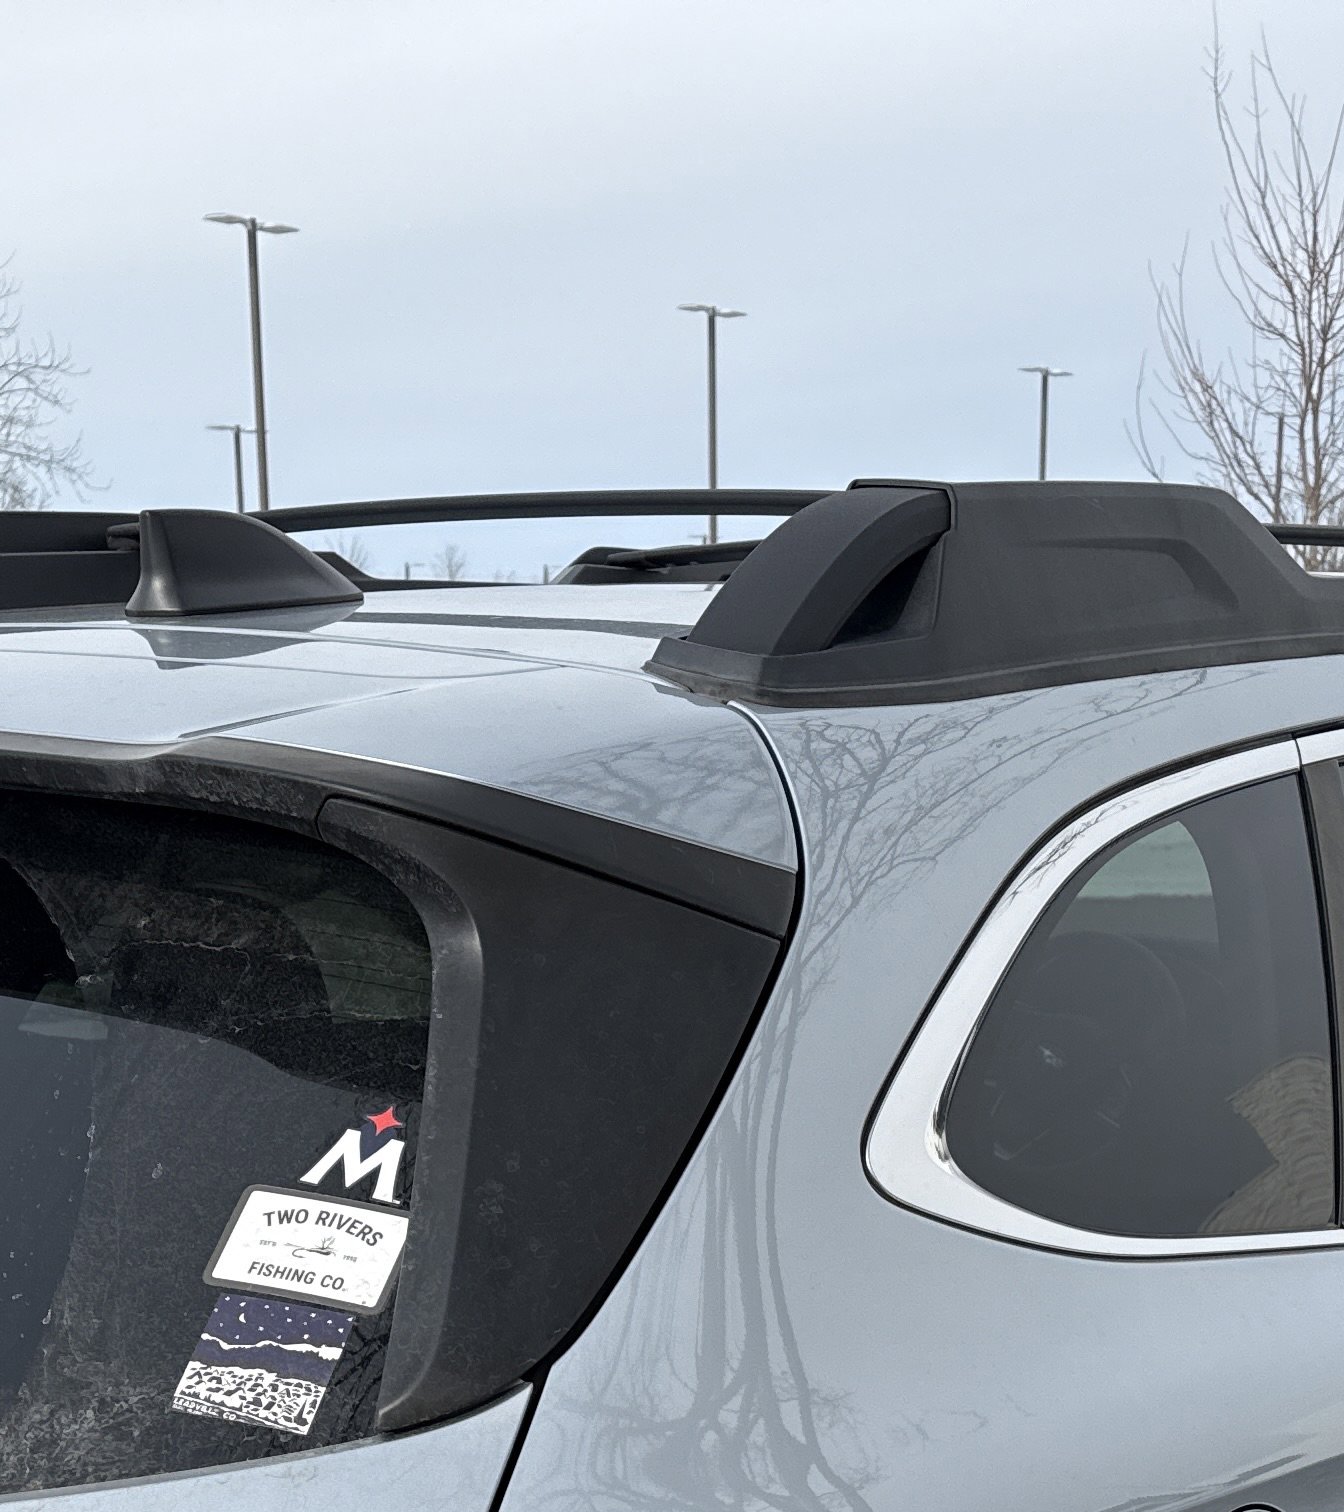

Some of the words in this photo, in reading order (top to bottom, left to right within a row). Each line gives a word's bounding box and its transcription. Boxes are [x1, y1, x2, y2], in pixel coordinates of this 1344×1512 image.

[262, 1208, 309, 1227] TWO
[314, 1209, 384, 1247] RIVERS
[247, 1261, 316, 1285] FISHING
[320, 1274, 345, 1292] CO.
